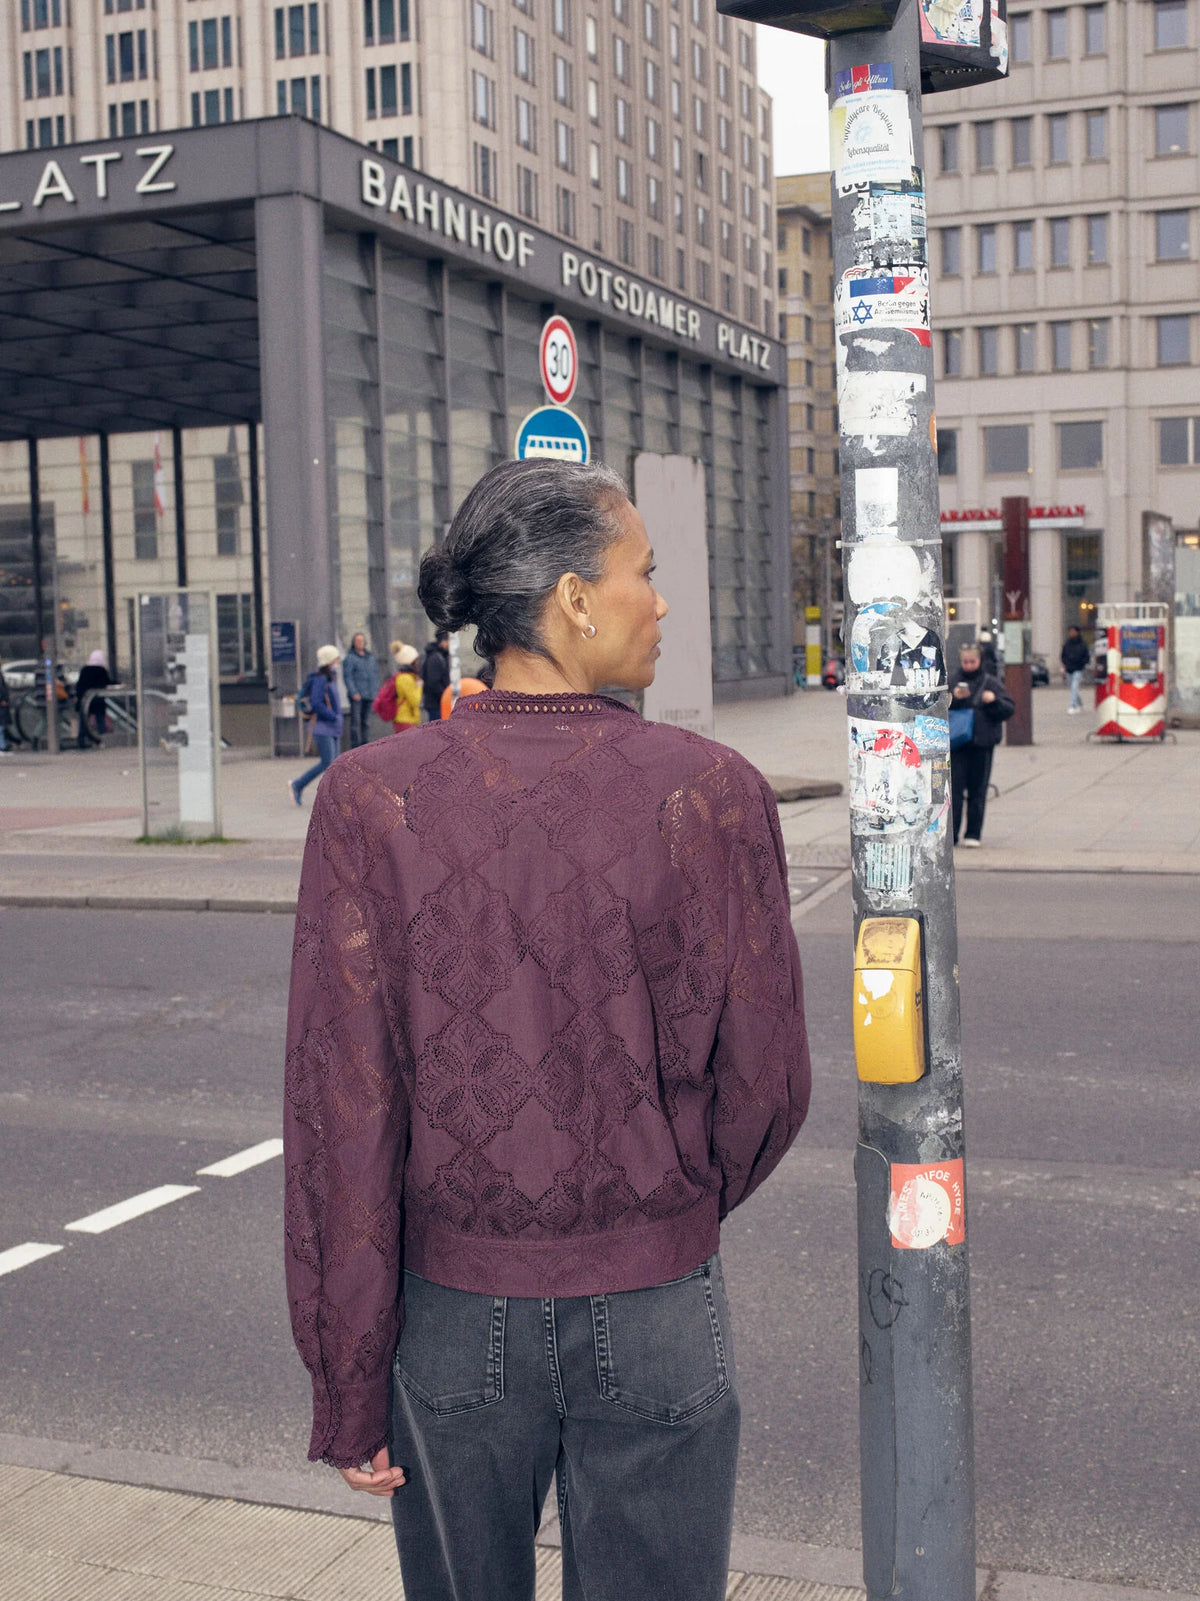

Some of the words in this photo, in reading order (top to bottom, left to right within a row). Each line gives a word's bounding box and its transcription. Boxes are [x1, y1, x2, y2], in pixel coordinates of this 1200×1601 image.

[0, 144, 176, 211] ATZ
[361, 158, 535, 268] BAHNHOF
[561, 251, 701, 341] POTSDAMER
[717, 322, 771, 371] PLATZ
[550, 341, 570, 380] 30
[940, 508, 1003, 521] ARAVAN
